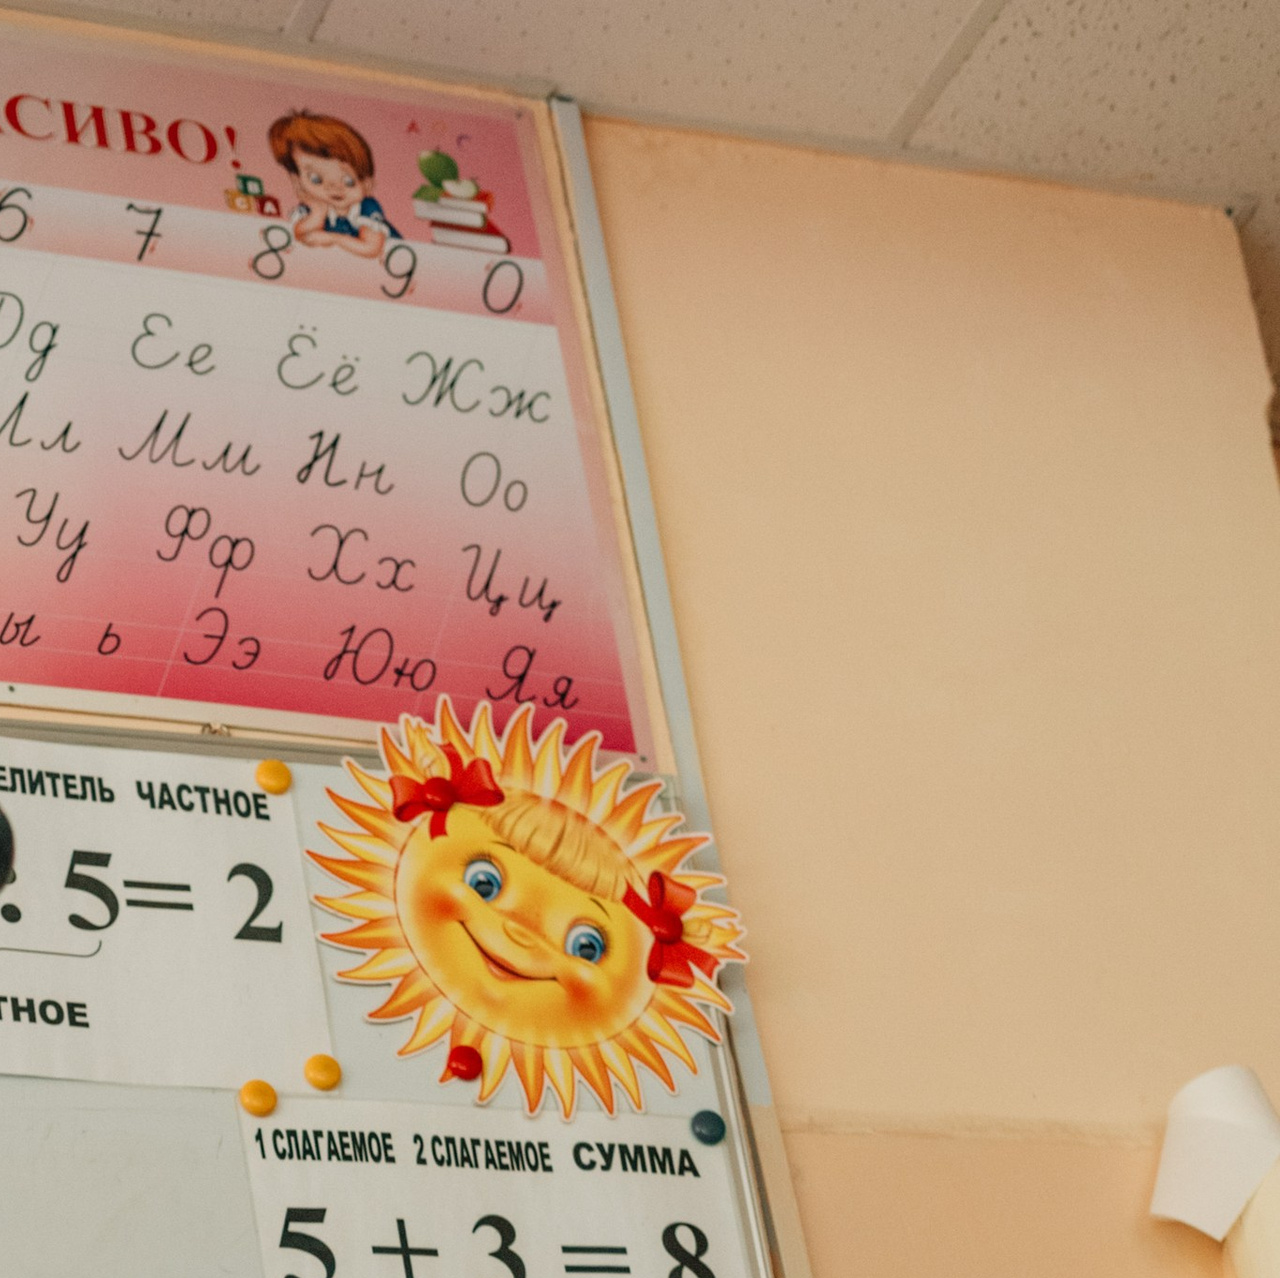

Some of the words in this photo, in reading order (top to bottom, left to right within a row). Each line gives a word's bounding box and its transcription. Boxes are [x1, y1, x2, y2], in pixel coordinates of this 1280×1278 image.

[127, 204, 162, 262] 7
[249, 225, 292, 281] 8
[380, 242, 417, 300] 9
[482, 261, 524, 316] 0
[136, 781, 270, 820] ЧАСТНОЕ
[227, 863, 283, 943] 2
[255, 1128, 266, 1159] 1
[272, 1129, 395, 1163] СЛАГАЕМОЕ
[413, 1134, 427, 1165] 2
[431, 1135, 553, 1172] СЛАГАЕМОЕ
[573, 1142, 700, 1177] СУММА
[562, 1246, 630, 1274] =
